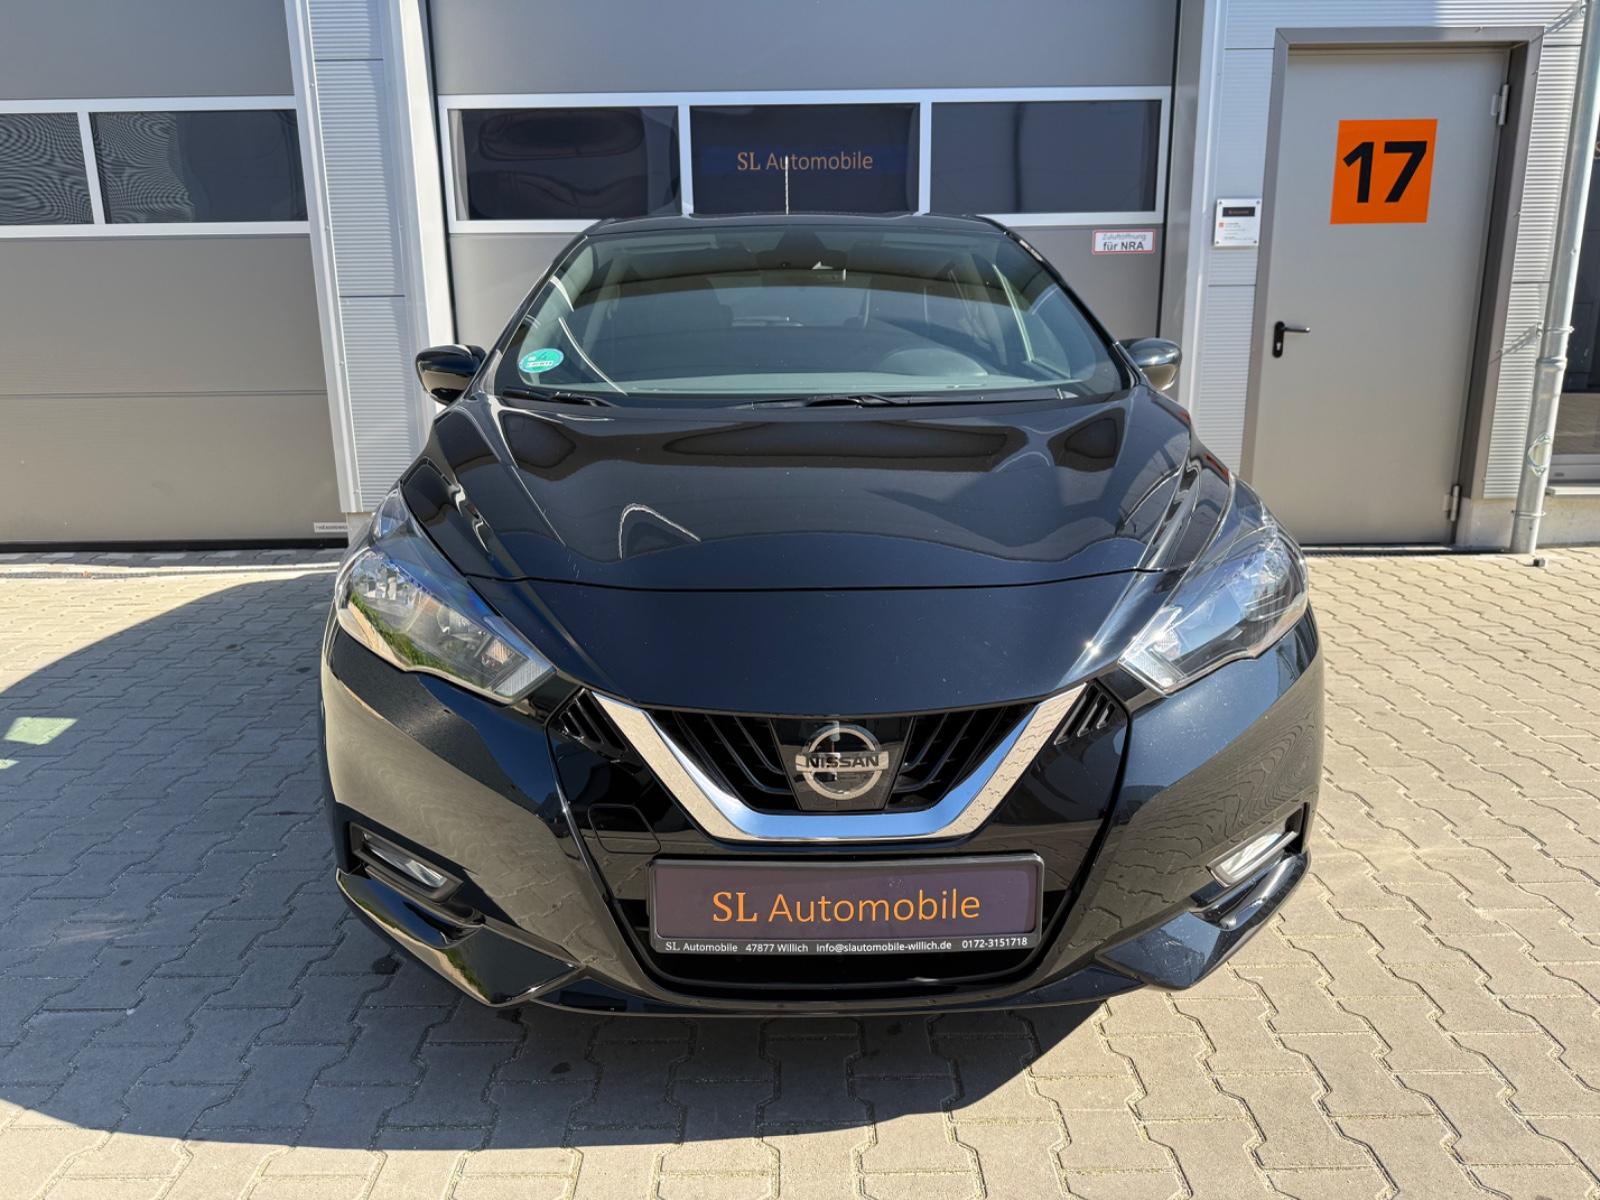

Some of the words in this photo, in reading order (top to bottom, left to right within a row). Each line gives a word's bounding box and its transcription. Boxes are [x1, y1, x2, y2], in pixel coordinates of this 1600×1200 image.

[737, 152, 761, 171] SL
[766, 151, 873, 171] Automobile
[1343, 141, 1427, 203] 17
[1103, 241, 1118, 251] für
[1121, 241, 1144, 250] NRA
[806, 756, 879, 769] NISSAN
[712, 891, 758, 922] SL
[768, 888, 981, 922] Automobile
[665, 942, 681, 951] SL
[683, 942, 738, 952] Automobile
[745, 943, 774, 953] 47877
[777, 943, 809, 953] Willich
[816, 940, 952, 953] info@slautomobile-willich.de
[962, 936, 1028, 949] 0172-3151718
